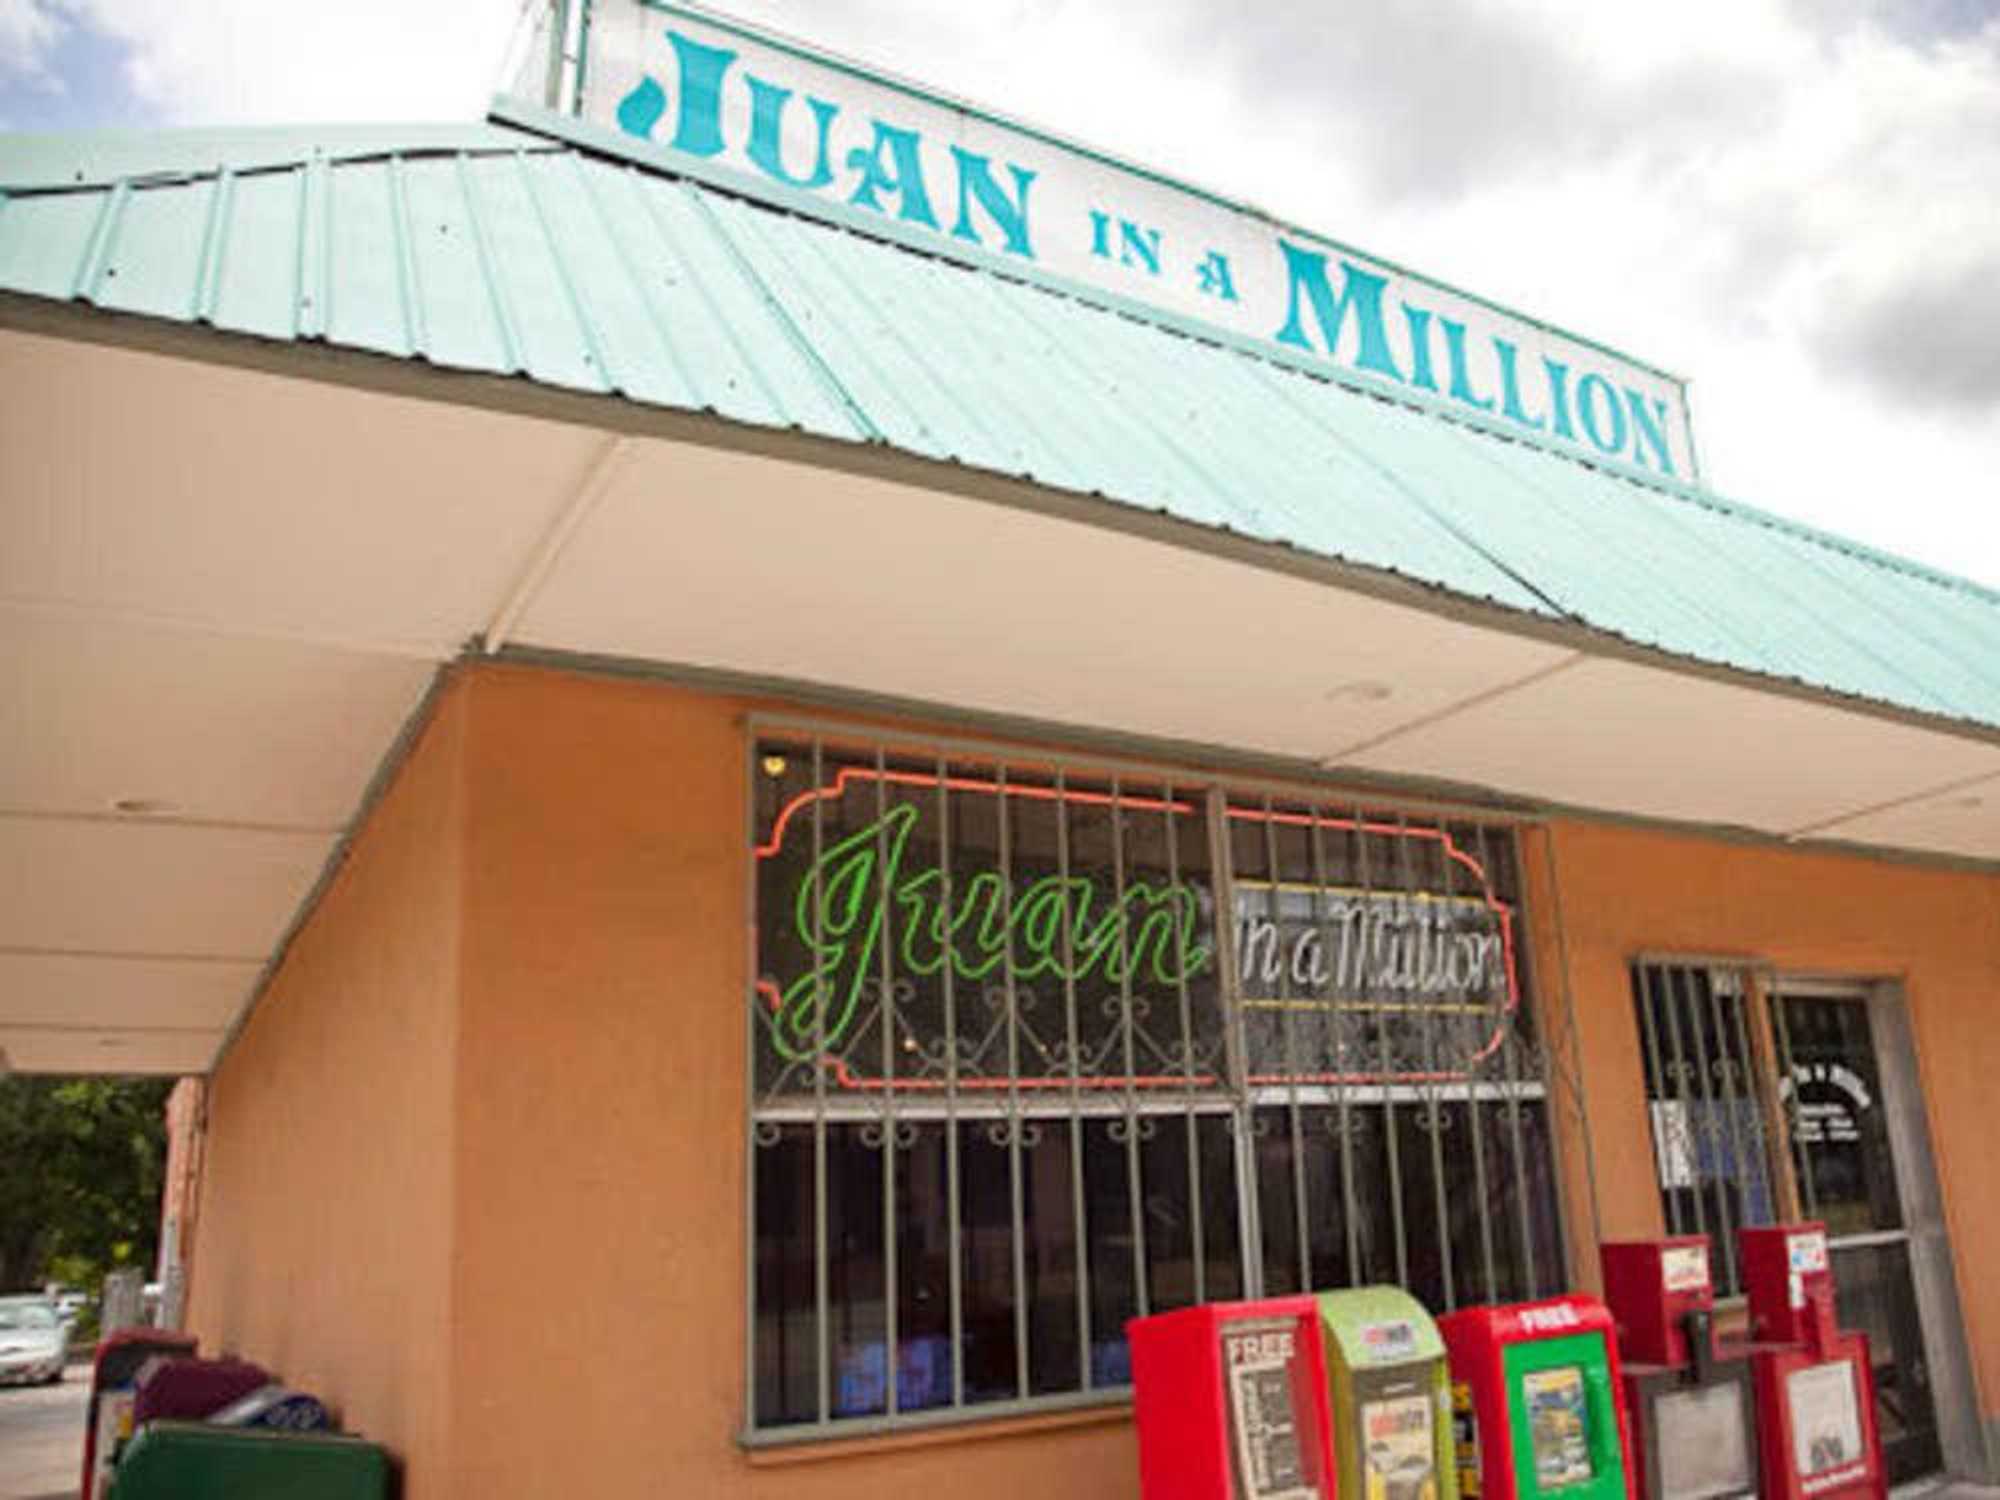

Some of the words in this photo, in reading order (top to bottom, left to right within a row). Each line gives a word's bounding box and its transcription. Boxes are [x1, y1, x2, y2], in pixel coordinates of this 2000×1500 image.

[616, 30, 1036, 258] JUAN
[1089, 210, 1161, 274] IN
[1195, 248, 1239, 301] A
[1275, 238, 1674, 474] MILLION
[772, 803, 1206, 1060] Juan
[1292, 926, 1329, 985] a
[1328, 896, 1506, 990] Million
[1226, 1333, 1295, 1364] FREE
